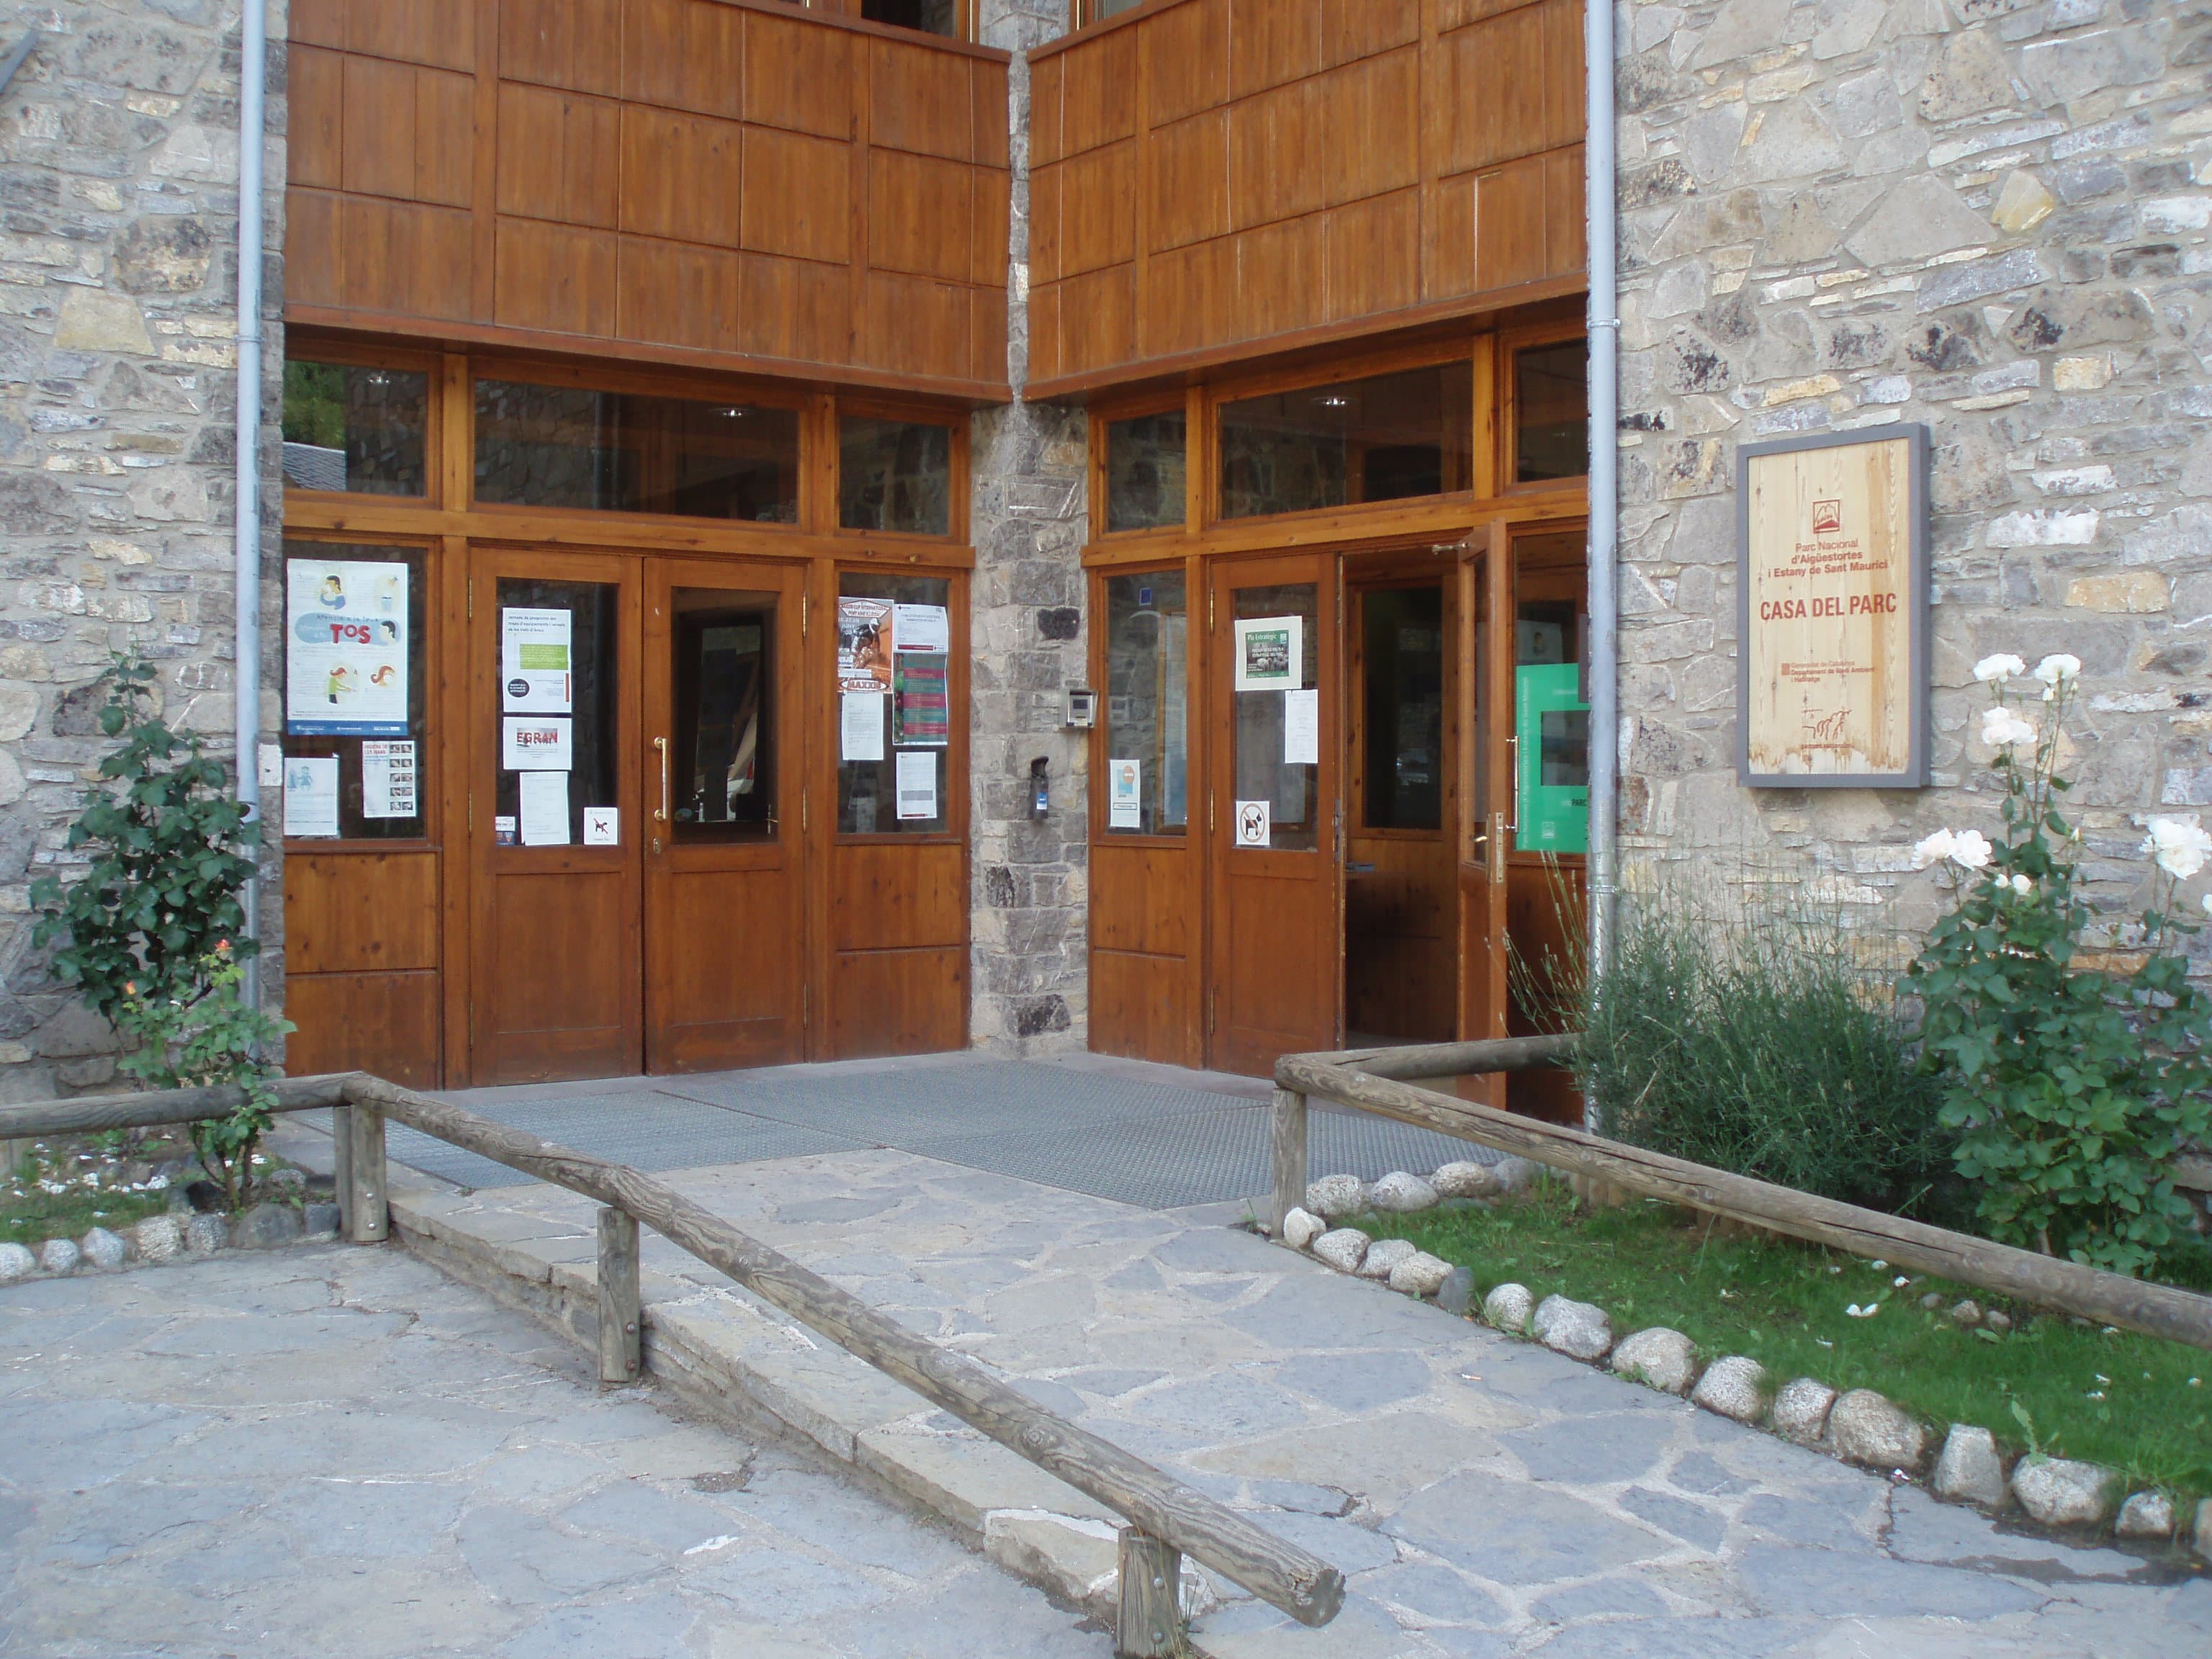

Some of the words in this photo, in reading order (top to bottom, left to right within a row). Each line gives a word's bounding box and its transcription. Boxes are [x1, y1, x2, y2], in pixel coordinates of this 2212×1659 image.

[1795, 542, 1816, 553] Parc
[1818, 538, 1859, 551] Nacional
[1791, 551, 1863, 565] d'Aigüestortes
[1768, 568, 1771, 578] i
[1773, 567, 1807, 578] Estany
[1809, 565, 1822, 575] de
[1824, 563, 1848, 574] Sant
[1850, 559, 1889, 572] Maurici
[1760, 598, 1807, 621] CASA
[1812, 597, 1845, 618] DEL
[1849, 593, 1897, 616] PARC
[329, 623, 372, 644] TOS
